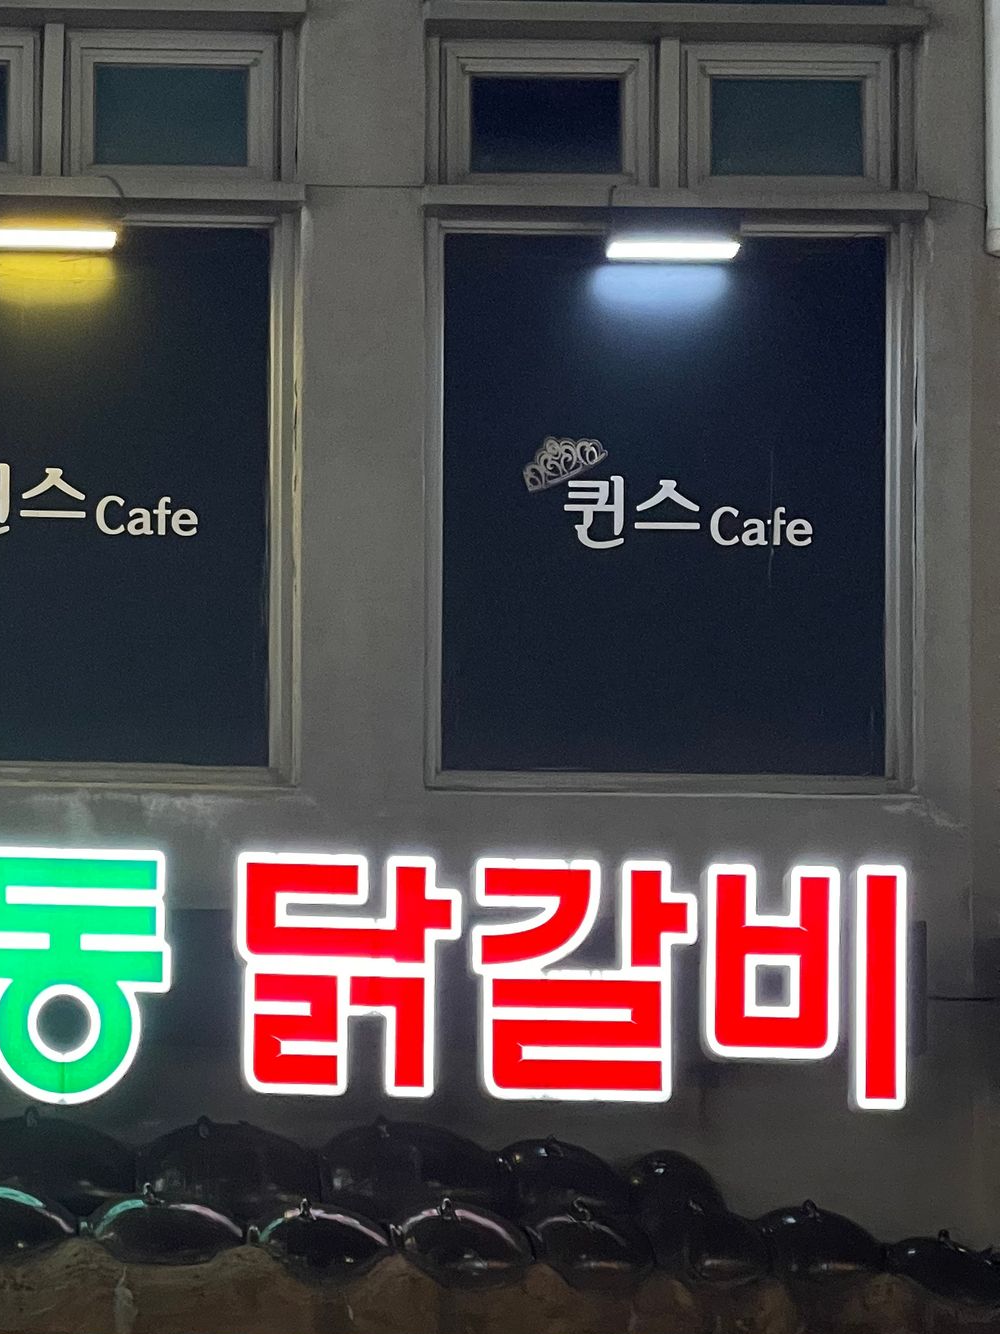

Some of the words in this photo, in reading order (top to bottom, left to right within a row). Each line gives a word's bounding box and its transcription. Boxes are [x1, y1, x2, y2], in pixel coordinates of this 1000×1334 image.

[96, 495, 198, 538] Cafe
[563, 475, 700, 549] 퀸스
[710, 507, 813, 548] Cafe
[235, 851, 907, 1110] 닭갈비
